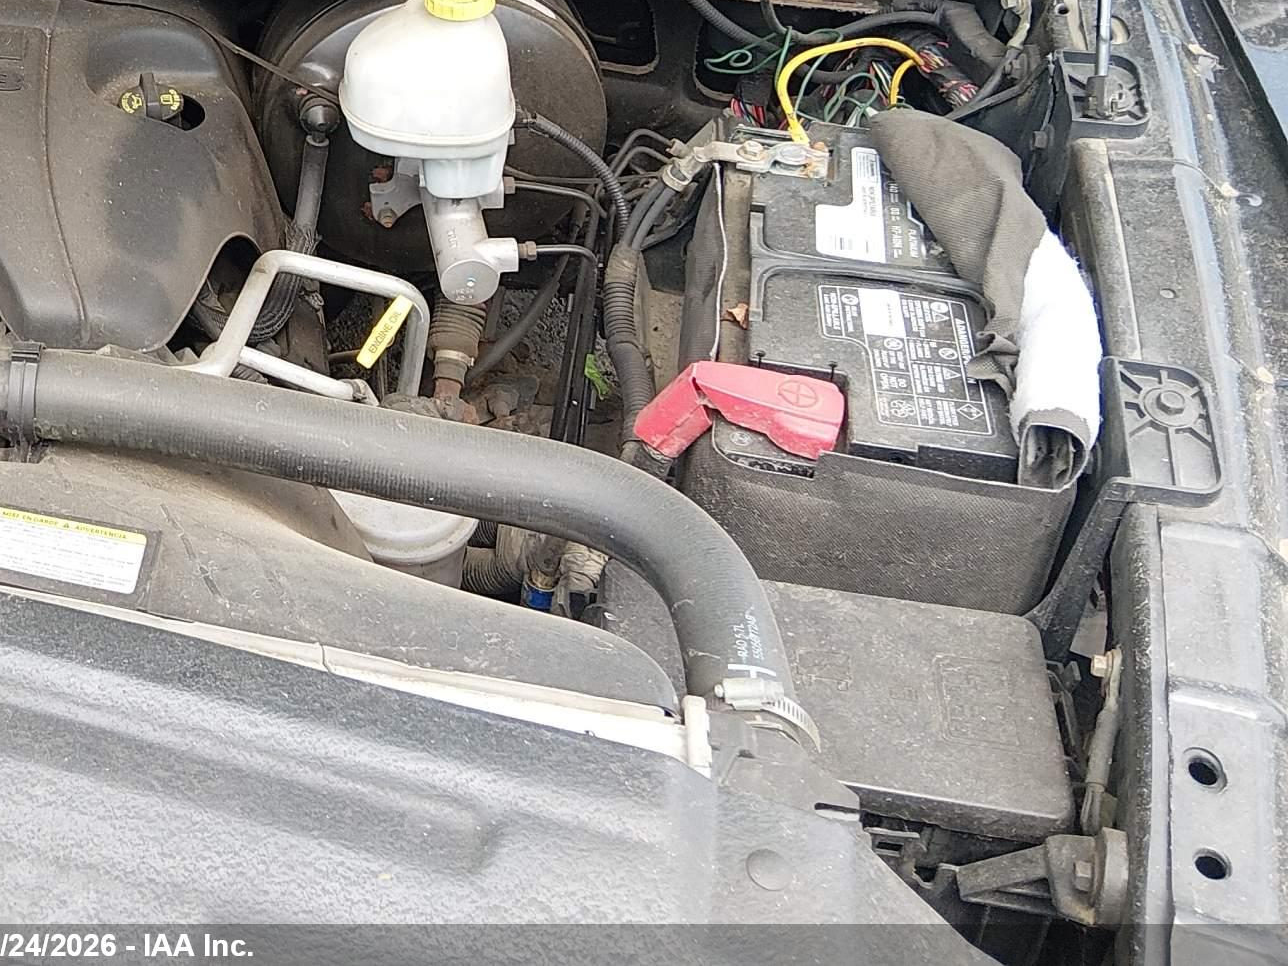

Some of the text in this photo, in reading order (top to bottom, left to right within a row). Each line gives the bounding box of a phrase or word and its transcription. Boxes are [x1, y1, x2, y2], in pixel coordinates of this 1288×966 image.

[907, 228, 919, 258] PLATINUM
[368, 312, 402, 354] ENGINE OIL
